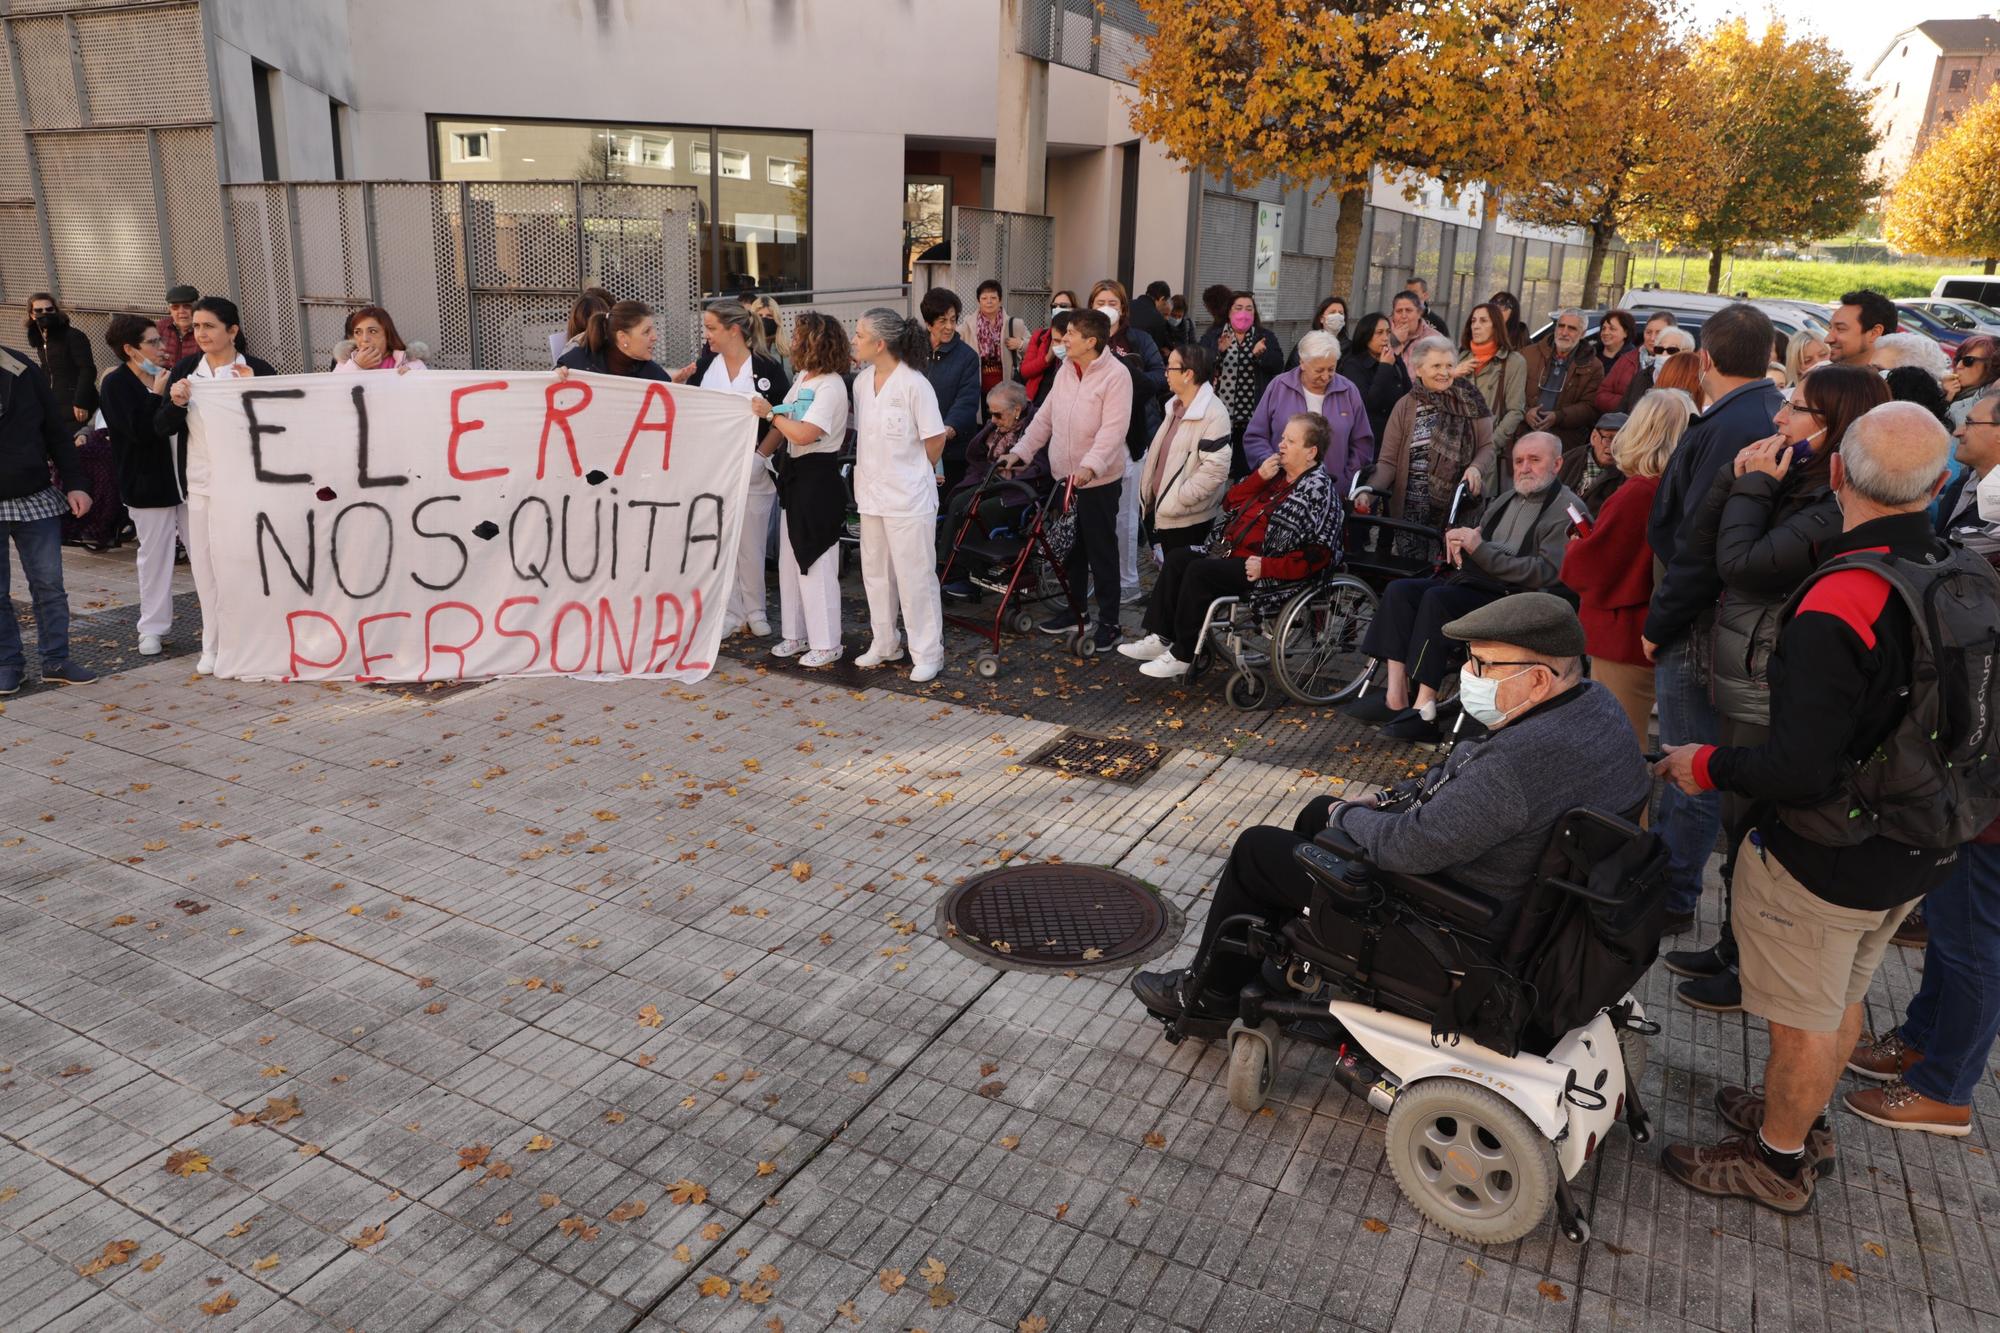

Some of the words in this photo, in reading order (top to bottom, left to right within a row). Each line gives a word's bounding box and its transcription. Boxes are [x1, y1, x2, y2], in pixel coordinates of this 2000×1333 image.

[447, 380, 677, 480] ERA
[256, 495, 469, 599] NOS
[281, 589, 711, 684] PERSONAL
